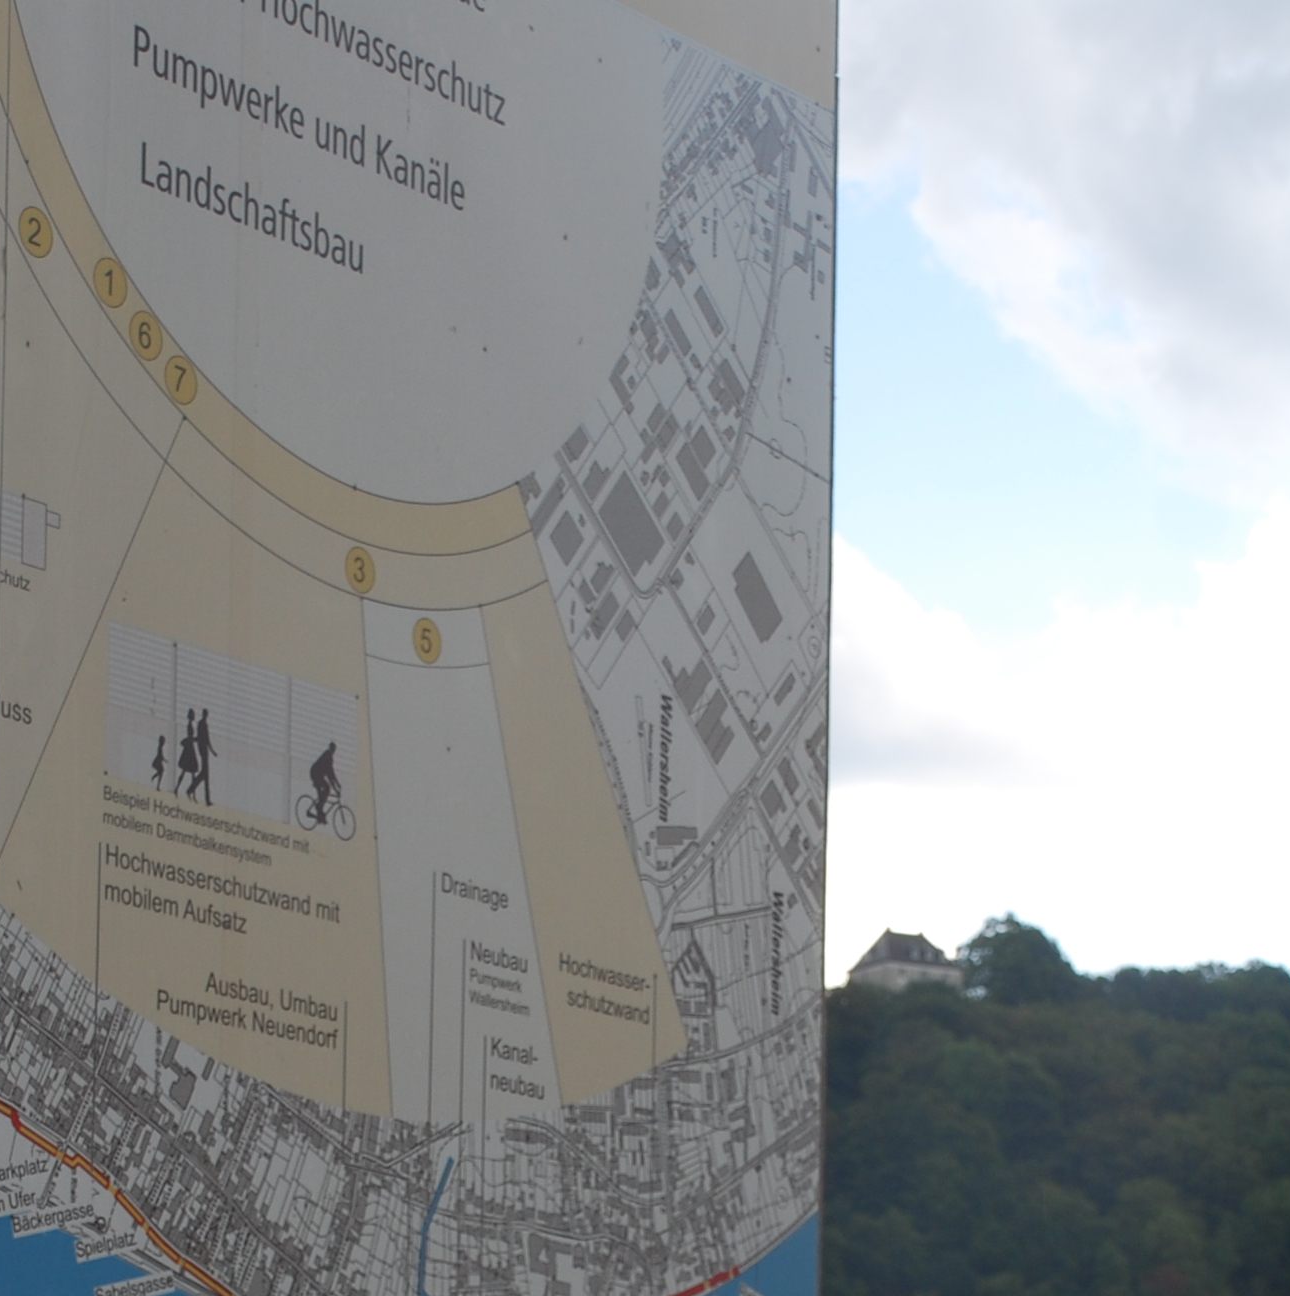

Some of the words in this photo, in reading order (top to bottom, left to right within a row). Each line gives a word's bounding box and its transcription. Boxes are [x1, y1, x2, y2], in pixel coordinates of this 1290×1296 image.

[132, 23, 306, 139] Pumpwerke
[314, 116, 366, 167] und
[375, 134, 466, 211] Kanäle
[140, 141, 365, 274] Landschaftsbau
[28, 217, 42, 247] 2
[104, 268, 115, 297] 1
[138, 321, 152, 350] 6
[174, 364, 188, 393] 7
[353, 557, 366, 584] 3
[420, 627, 433, 654] 5
[659, 693, 674, 823] Wallersheim
[102, 785, 150, 812] Beispiel
[152, 796, 290, 850] Hochwasserschutzwand
[292, 838, 311, 856] mit
[102, 810, 153, 836] mobilem
[156, 822, 272, 867] Dammbalkensystem
[105, 844, 311, 916] Hochwasserschutzwand
[315, 901, 341, 924] mit
[440, 871, 510, 912] Drainage
[103, 883, 179, 918] mobilem
[183, 899, 248, 935] Aufsatz
[469, 939, 529, 974] Neubau
[771, 891, 785, 1017] Wallersheim
[468, 967, 523, 993] Pumpwerk
[558, 952, 651, 993] Hochwasser-
[205, 971, 275, 1010] Ausbau,
[279, 987, 339, 1022] Umbau
[566, 989, 651, 1026] schutzwand
[156, 988, 247, 1030] Pumpwerk
[252, 1010, 339, 1050] Neuendorf
[490, 1035, 539, 1066] Kanal-
[489, 1072, 546, 1101] neubau
[9, 1190, 37, 1210] Ufer
[12, 1203, 95, 1233] Bäckergasse
[75, 1231, 137, 1260] Spielplatz
